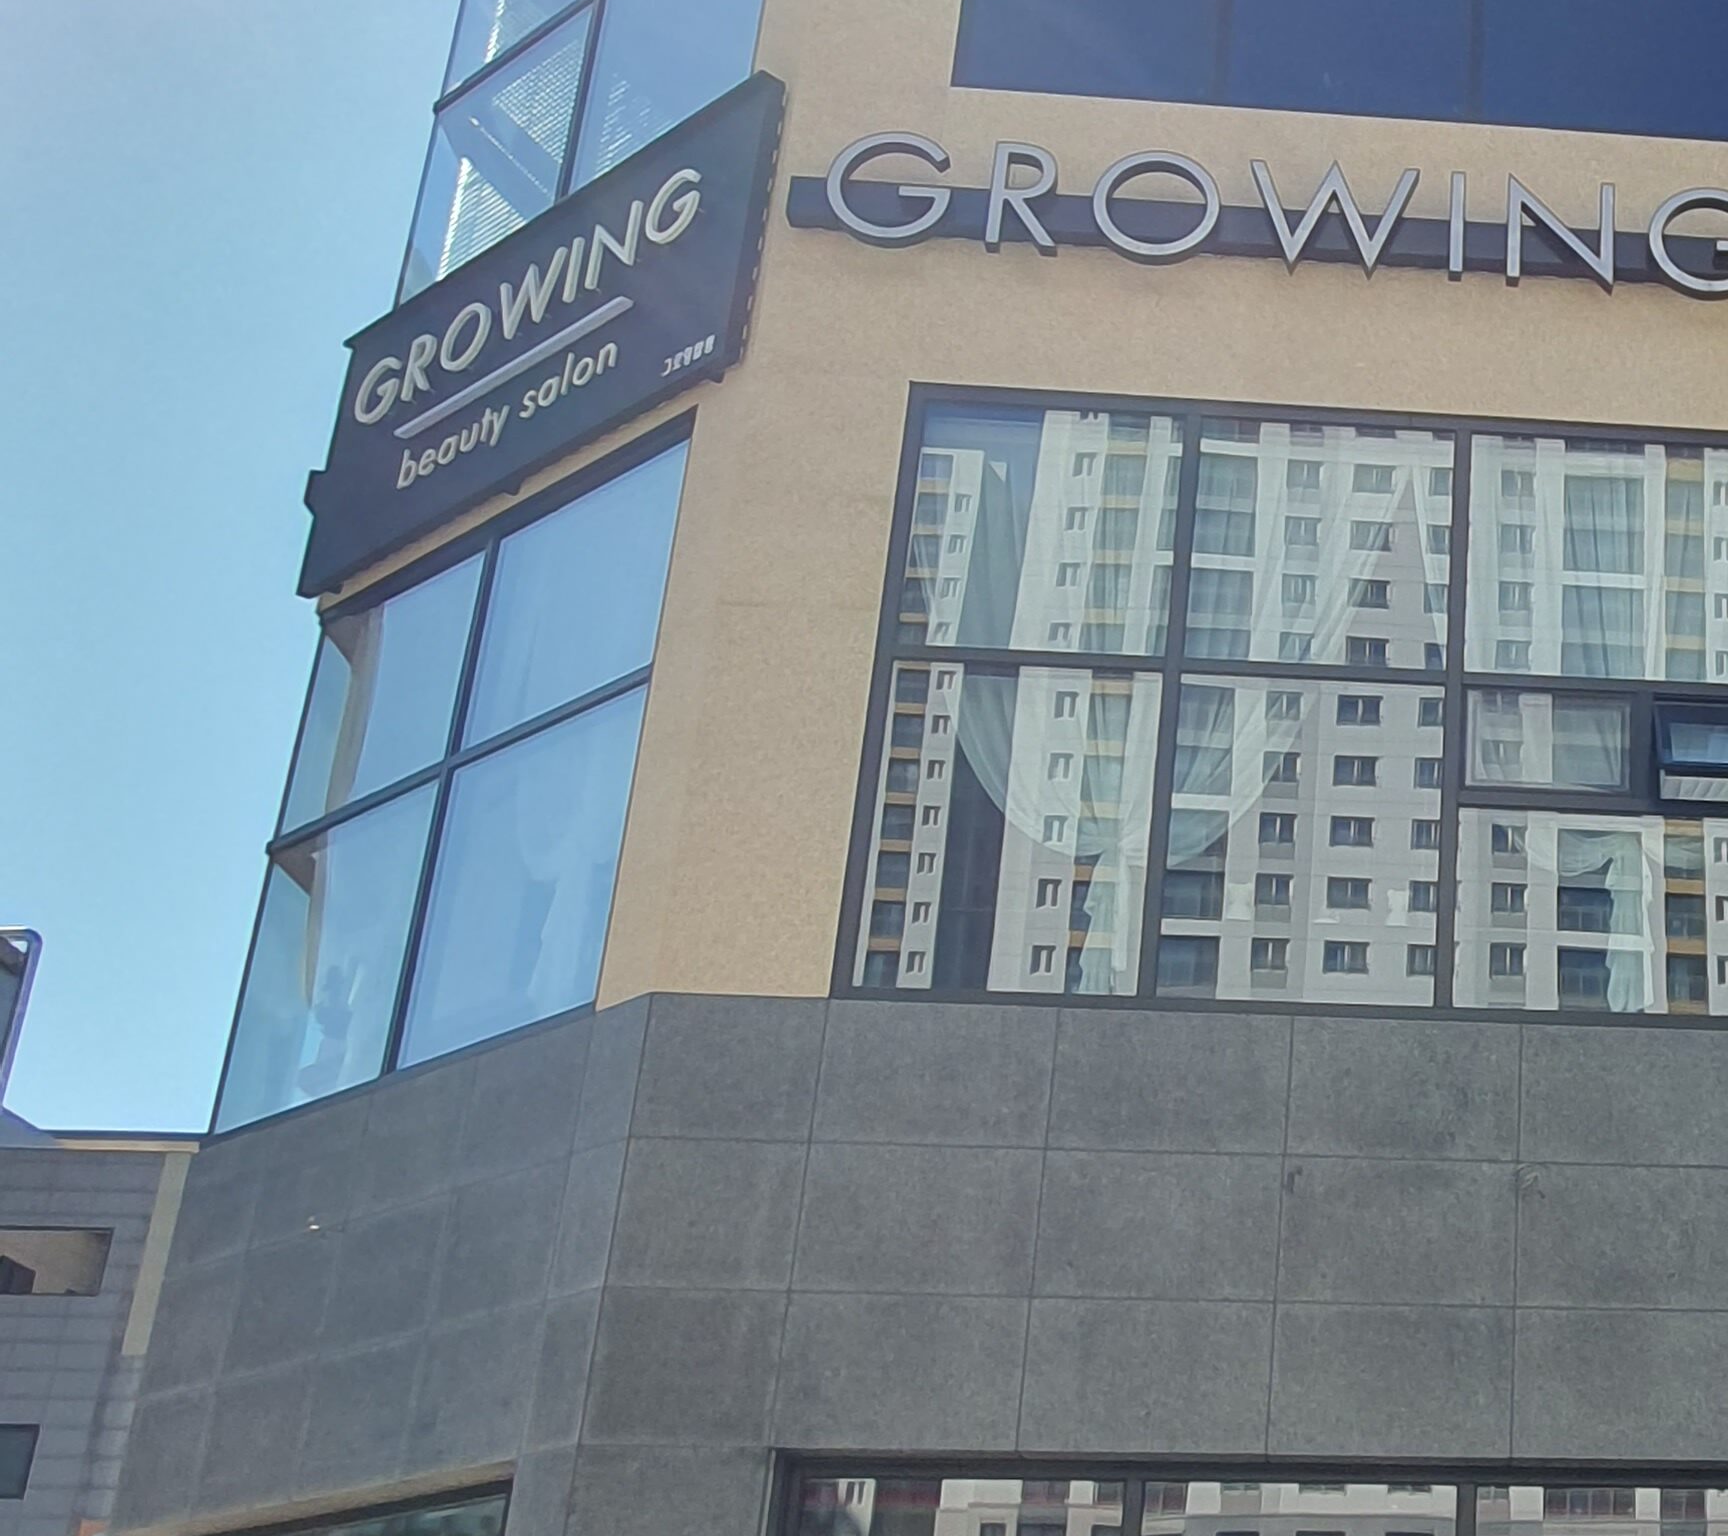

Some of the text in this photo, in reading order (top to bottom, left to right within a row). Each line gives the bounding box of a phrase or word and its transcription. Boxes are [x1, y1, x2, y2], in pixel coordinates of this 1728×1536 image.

[354, 167, 702, 425] GROWING
[396, 404, 511, 490] beauty
[519, 341, 618, 419] salon
